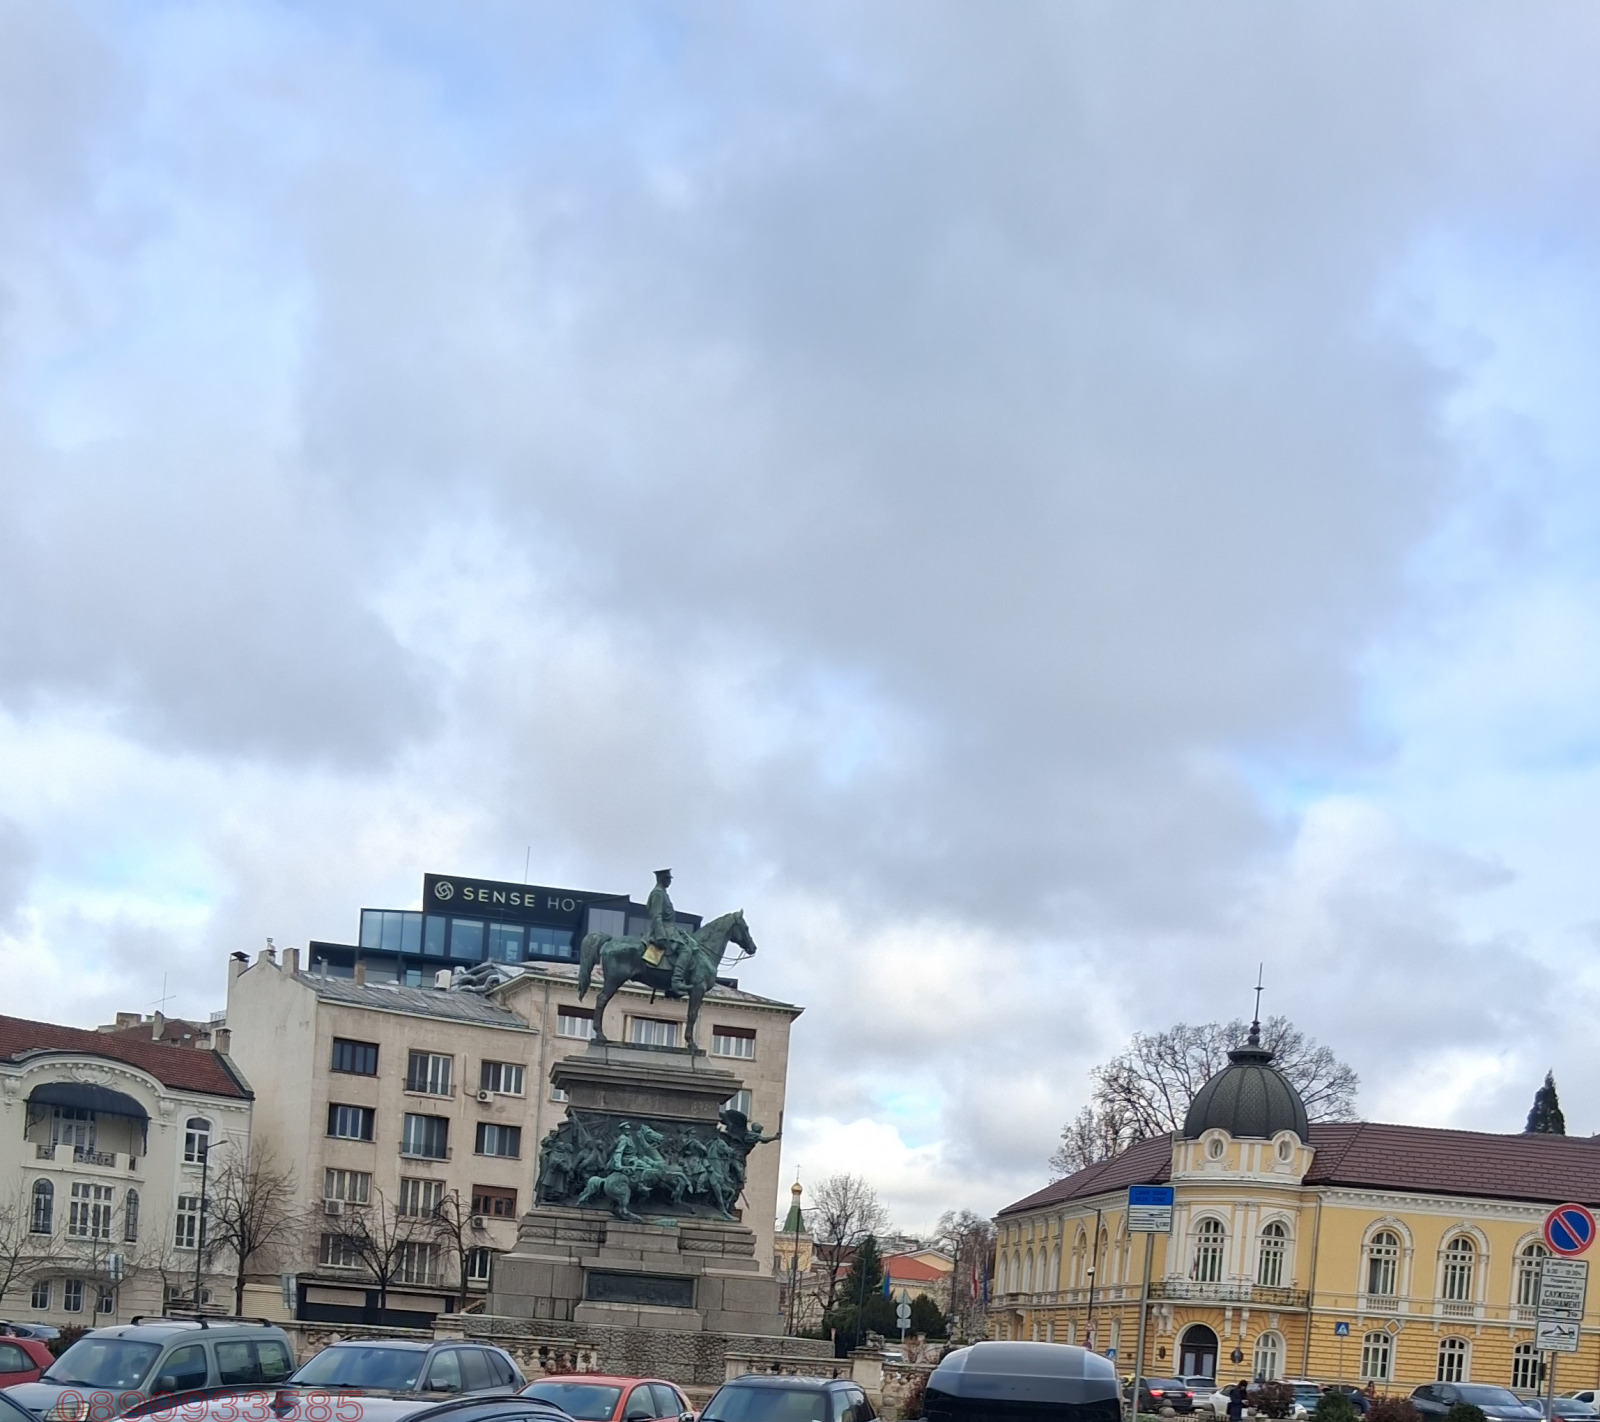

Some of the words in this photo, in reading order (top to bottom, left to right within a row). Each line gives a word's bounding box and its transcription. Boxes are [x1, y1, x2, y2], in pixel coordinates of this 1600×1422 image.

[463, 887, 536, 908] SENSE
[1544, 1290, 1580, 1300] СЛУЖЕБЕН
[1541, 1298, 1582, 1309] АБОНАМЕНТ
